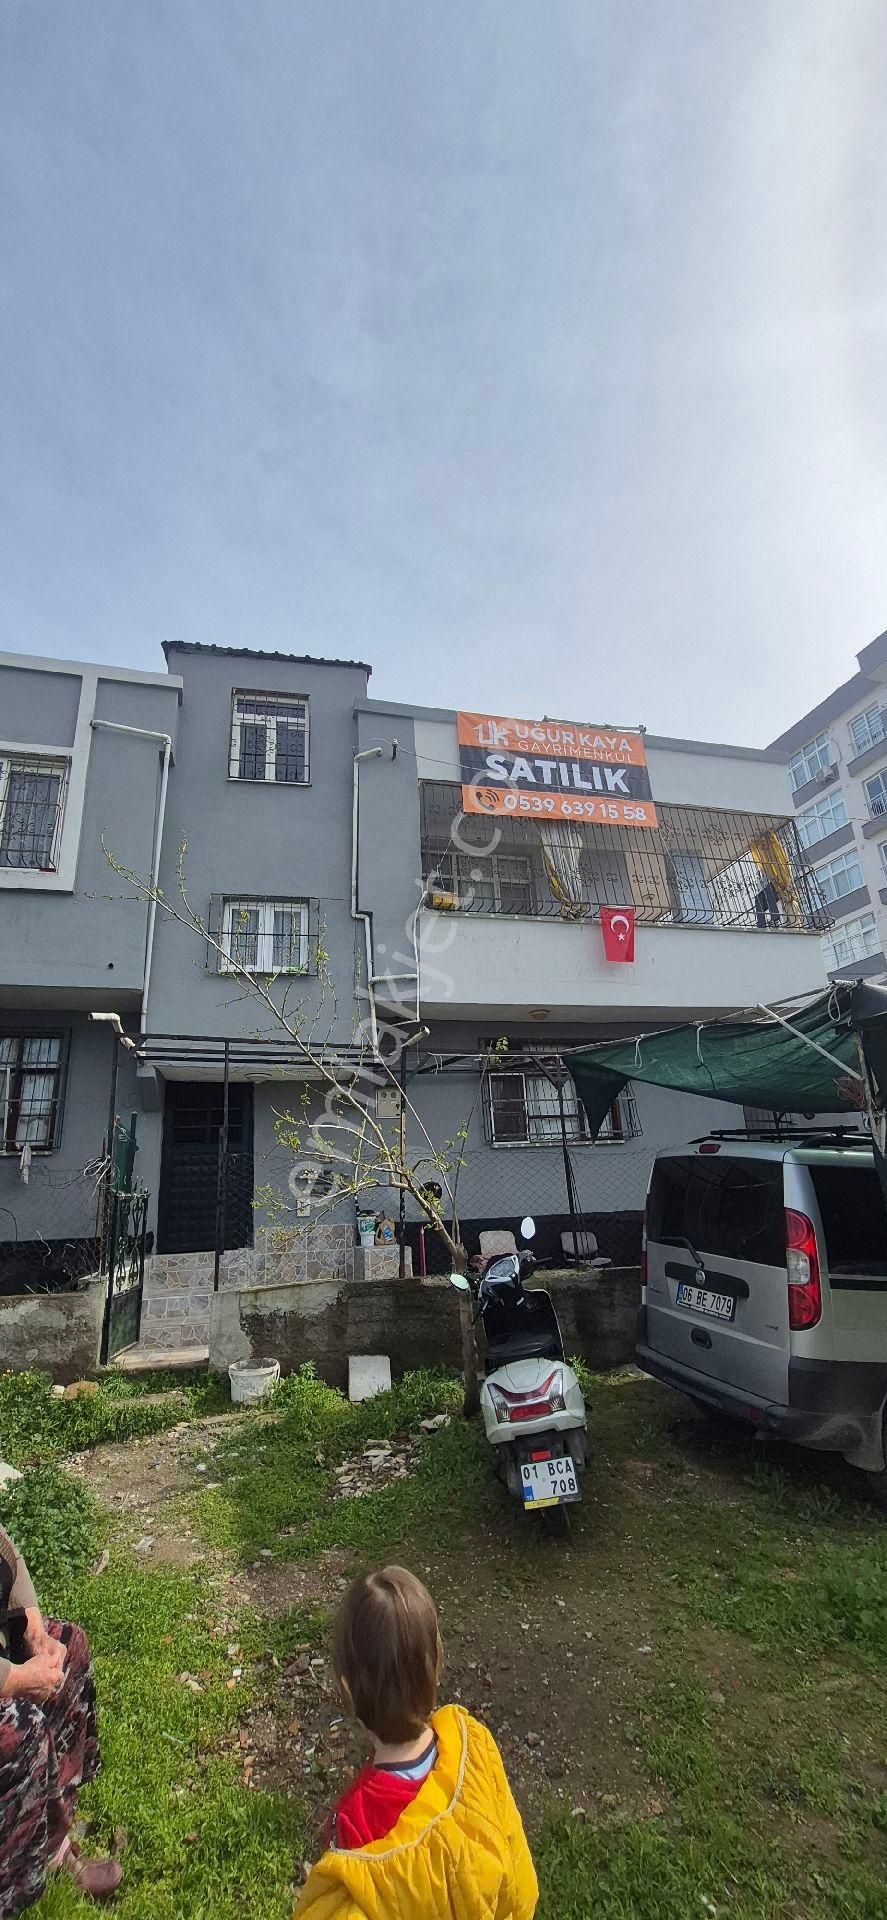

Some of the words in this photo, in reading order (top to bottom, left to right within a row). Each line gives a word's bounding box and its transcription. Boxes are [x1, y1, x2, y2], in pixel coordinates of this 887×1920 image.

[514, 723, 578, 746] UĞUR
[579, 734, 633, 752] KAYA
[485, 754, 631, 793] SATILIK
[503, 793, 556, 813] 0539
[560, 800, 596, 816] 639
[599, 803, 619, 819] 15
[623, 806, 647, 821] 58
[682, 1286, 693, 1302] 06
[696, 1290, 708, 1307] BE
[711, 1295, 732, 1314] 7079
[523, 1465, 538, 1480] 01
[547, 1459, 573, 1476] BCA
[550, 1477, 576, 1495] 708
